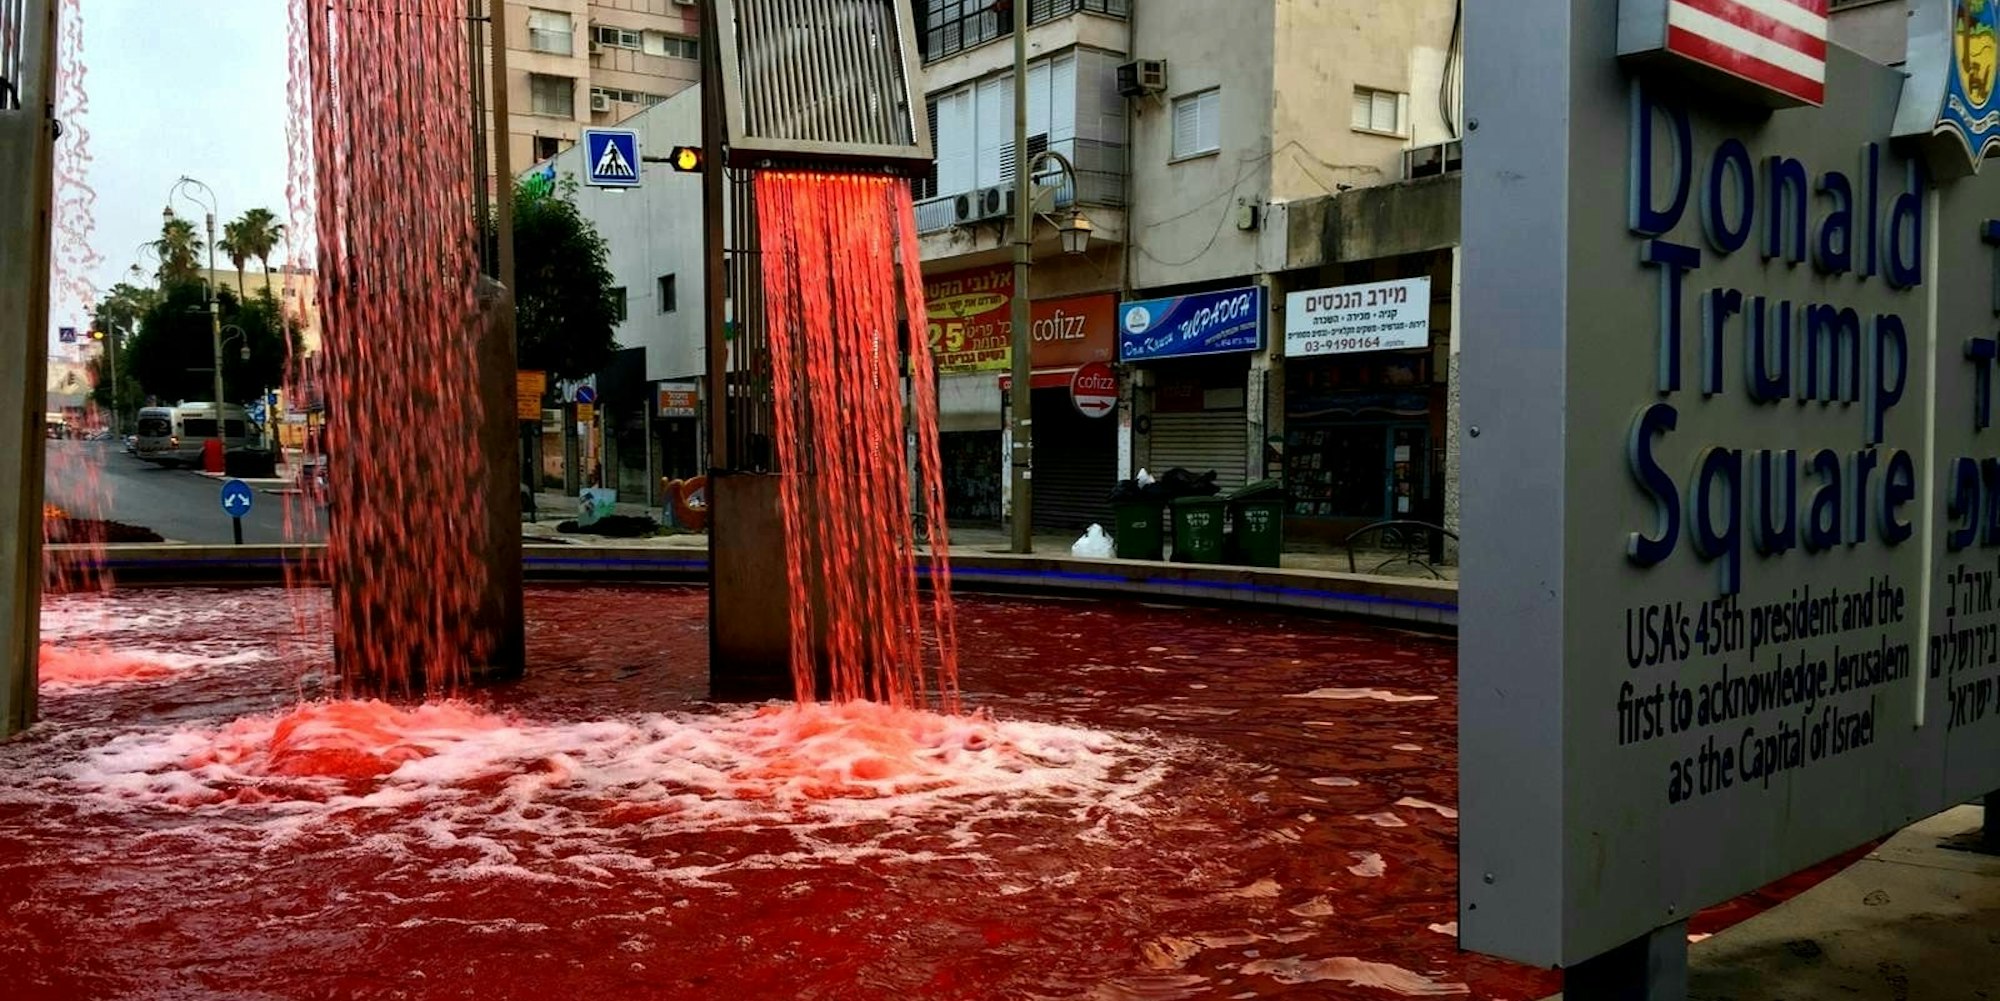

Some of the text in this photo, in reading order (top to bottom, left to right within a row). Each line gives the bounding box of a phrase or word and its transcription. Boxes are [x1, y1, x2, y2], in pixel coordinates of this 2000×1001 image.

[1629, 80, 1922, 289] Donald
[1033, 309, 1085, 340] cofizz
[1306, 287, 1407, 312] מירב הנכסים
[1346, 311, 1371, 322] מכירה
[928, 323, 965, 352] 25
[1305, 337, 1380, 352] 03-9190164
[1641, 240, 1907, 446] Trump
[1078, 373, 1114, 390] cofizz
[1627, 403, 1915, 595] Square
[1626, 574, 1905, 669] USA's 45th president and the
[1930, 618, 1997, 679] בירושלים
[1617, 633, 1909, 746] first to acknowledge Jerusalem
[1947, 677, 1992, 733] ישראל
[1668, 694, 1875, 804] as the Capital of Israel
